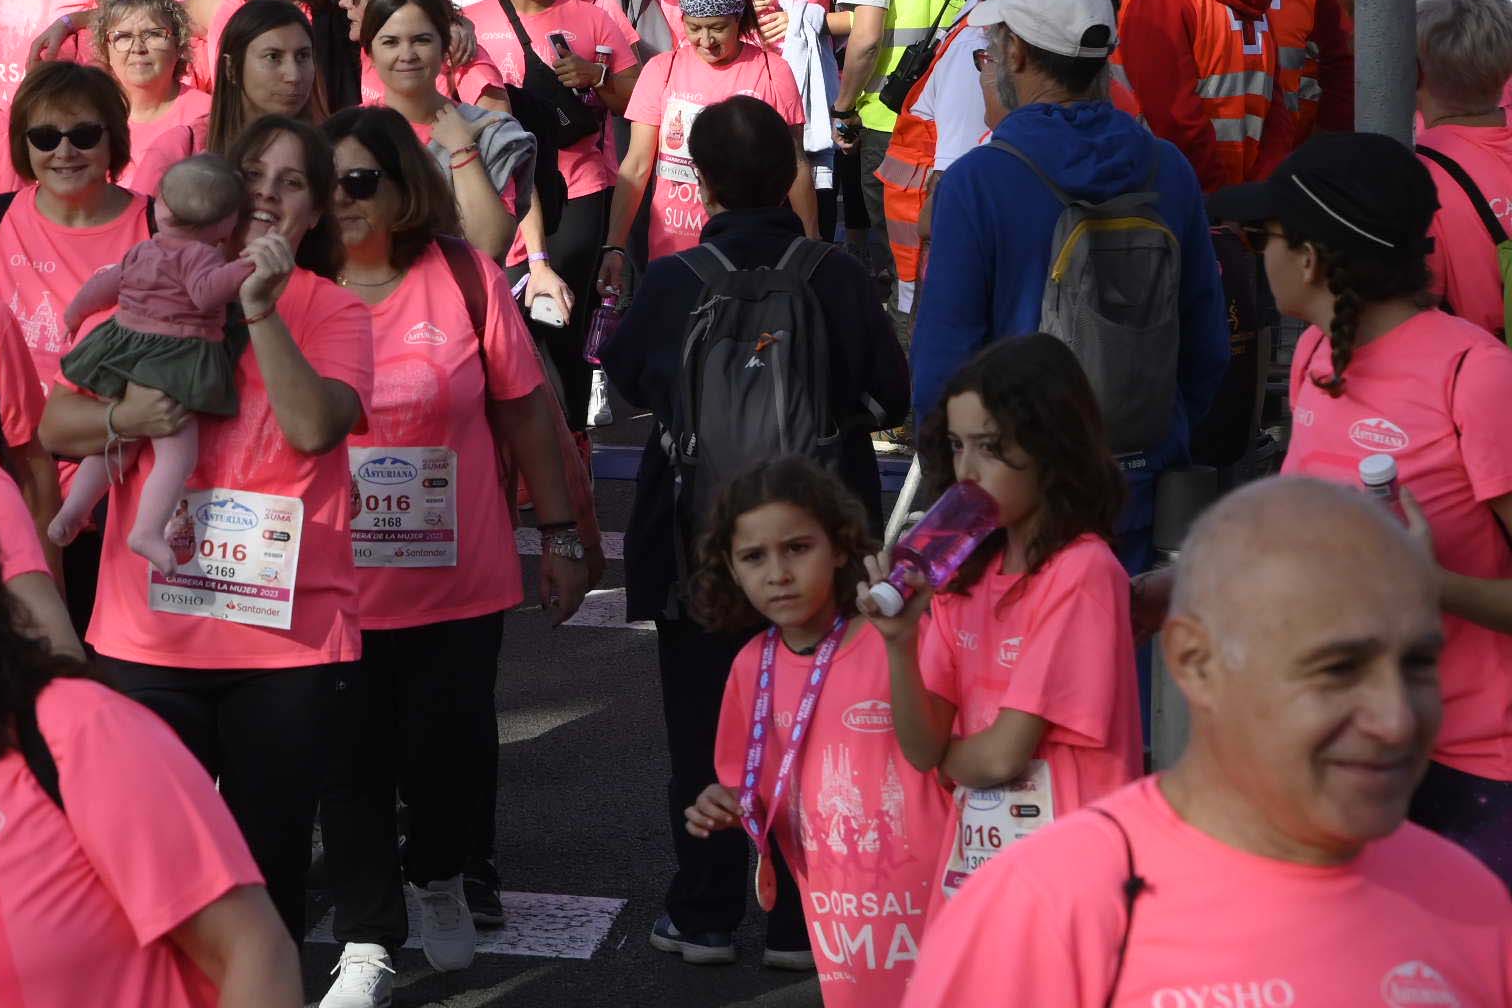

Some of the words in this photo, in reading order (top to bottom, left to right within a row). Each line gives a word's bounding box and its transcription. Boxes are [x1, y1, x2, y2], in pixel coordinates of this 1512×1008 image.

[363, 468, 414, 479] ASTURIANA
[365, 494, 411, 512] 016
[373, 517, 402, 528] 2168
[199, 539, 248, 562] 016
[206, 563, 236, 579] 2169
[160, 591, 204, 606] OYSHO
[236, 602, 281, 617] Santander
[964, 824, 1002, 849] 016
[810, 890, 922, 918] DORSAL
[1151, 979, 1296, 1008] OYSHO
